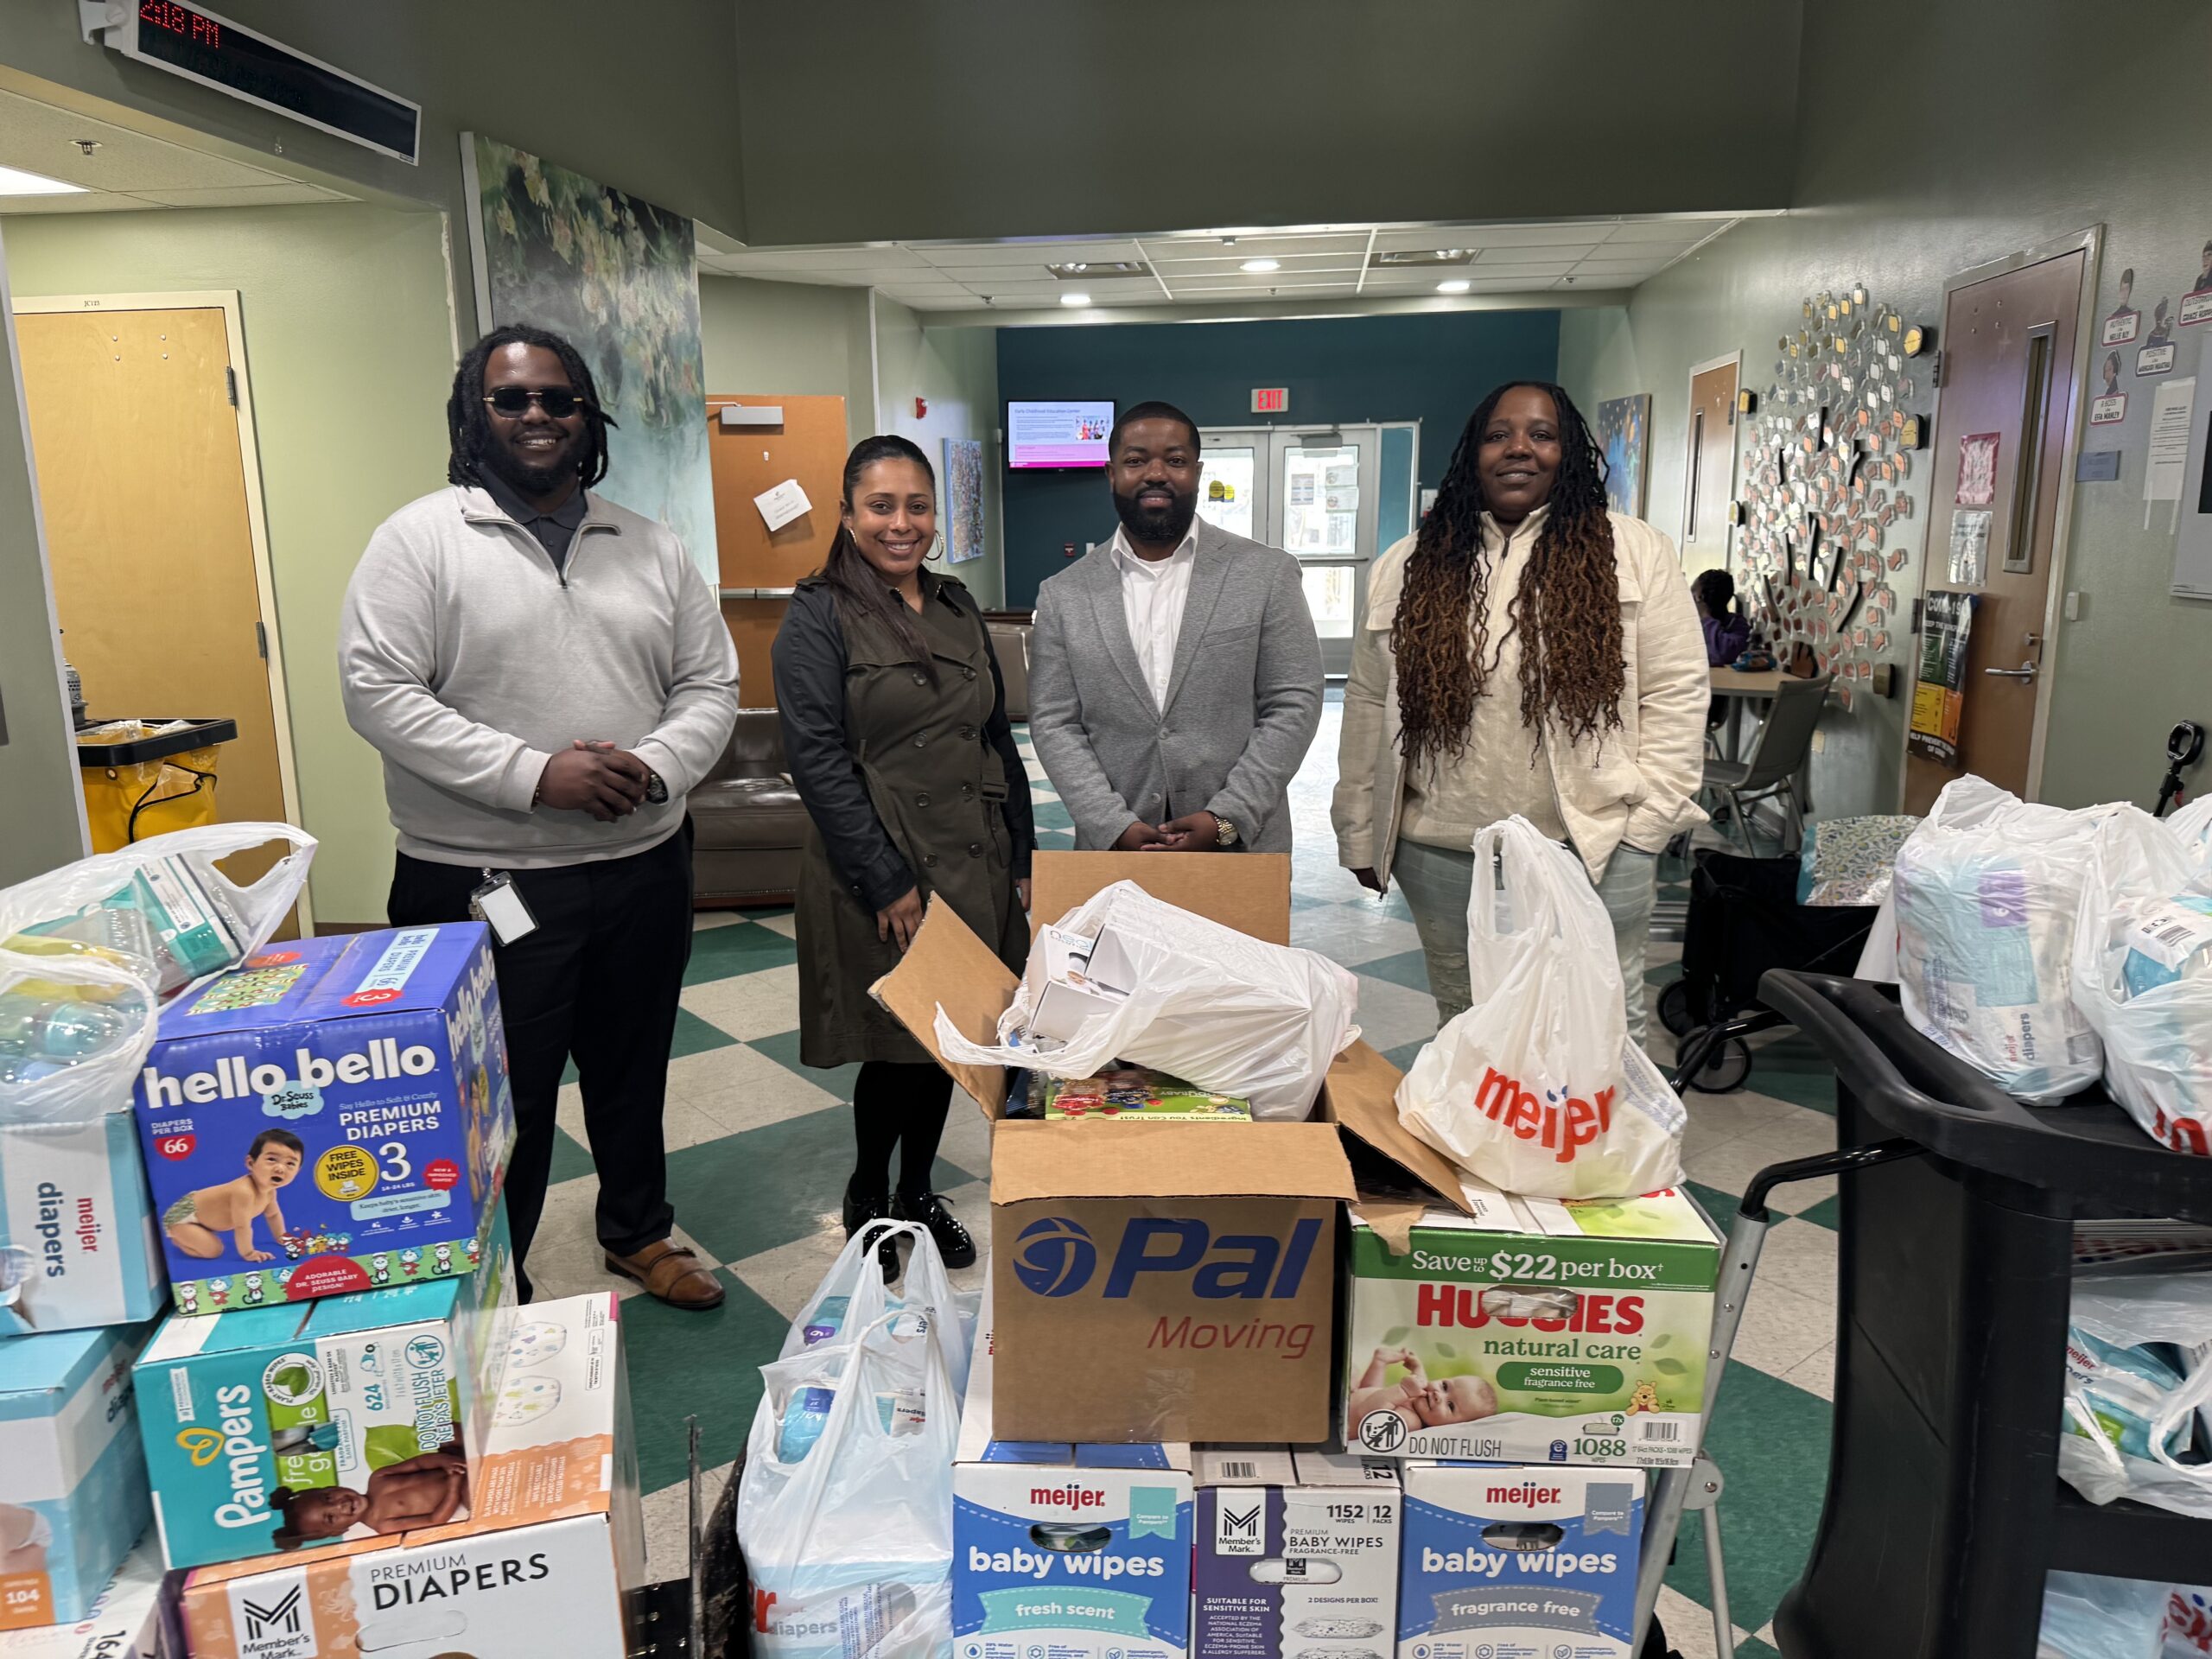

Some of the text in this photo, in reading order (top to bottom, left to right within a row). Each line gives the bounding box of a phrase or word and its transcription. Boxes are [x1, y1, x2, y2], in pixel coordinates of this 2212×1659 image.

[139, 0, 219, 48] 2:18 PM
[1257, 390, 1282, 410] EXIT
[2020, 1013, 2036, 1061] diapers
[143, 1037, 437, 1109] hello bello
[280, 1102, 308, 1111] Babies
[288, 1090, 314, 1102] Seuss
[355, 1100, 375, 1109] Hello
[151, 1118, 194, 1129] DIAPERS
[339, 1100, 442, 1126] PREMIUM
[1474, 1066, 1615, 1162] meijer
[152, 1124, 194, 1135] PER BOX
[346, 1116, 440, 1141] DIAPERS
[163, 1138, 188, 1154] 66
[329, 1150, 358, 1162] FREE
[326, 1159, 364, 1172] WIPES
[378, 1141, 411, 1182] 3
[328, 1168, 365, 1181] INSIDE
[35, 1182, 65, 1277] diapers
[75, 1198, 101, 1251] meijer
[1103, 1216, 1323, 1300] Pal
[1412, 1249, 1471, 1273] Save
[1473, 1257, 1487, 1266] up
[1473, 1264, 1484, 1273] to
[1489, 1249, 1557, 1281] $22
[305, 1269, 346, 1280] ADORABLE
[311, 1277, 336, 1286] SEUSS
[1560, 1261, 1602, 1281] per
[1147, 1315, 1315, 1359] Moving
[1484, 1338, 1641, 1360] natural care
[1530, 1366, 1591, 1378] sensitive
[264, 1374, 294, 1403] PLANT-BASED
[1524, 1377, 1595, 1389] fragrance free
[364, 1383, 384, 1411] 624
[431, 1368, 454, 1441] NE PAS JETER
[410, 1370, 437, 1450] DO NOT FLUSH
[340, 1420, 352, 1444] PARFUM
[213, 1384, 271, 1529] Pampers
[1409, 1437, 1502, 1457] DO NOT FLUSH
[1573, 1438, 1626, 1457] 1088
[1371, 1464, 1393, 1479] 12
[1030, 1484, 1105, 1510] meijer
[1485, 1481, 1561, 1508] meijer
[1326, 1505, 1392, 1518] 1152 12
[1219, 1537, 1261, 1547] Member's
[1289, 1537, 1383, 1548] BABY WIPES
[371, 1554, 467, 1582] PREMIUM
[968, 1548, 1165, 1581] baby wipes
[1422, 1548, 1617, 1578] baby wipes
[372, 1553, 550, 1611] DIAPERS
[5, 1588, 41, 1605] 104
[1014, 1600, 1116, 1621] fresh scent
[1452, 1599, 1580, 1618] fragrance free
[243, 1633, 311, 1654] Member's
